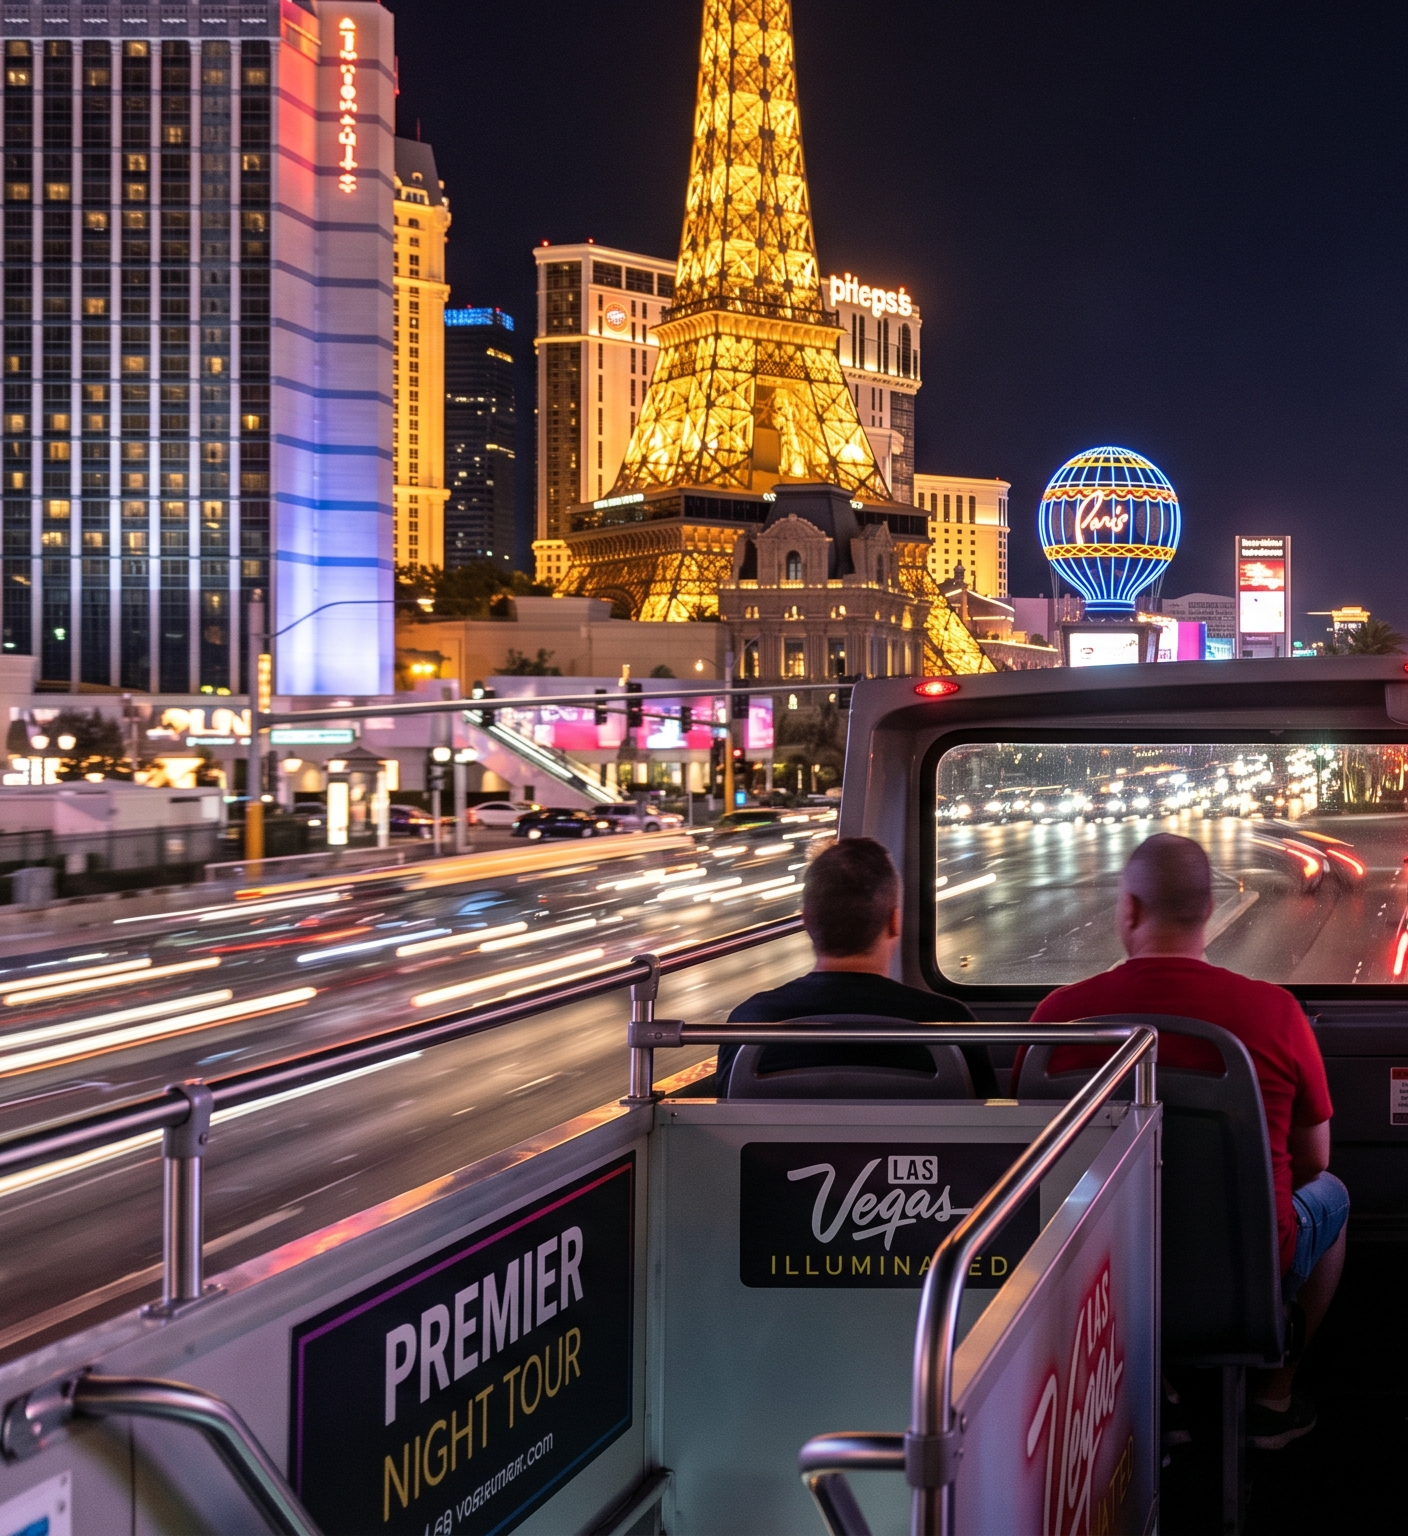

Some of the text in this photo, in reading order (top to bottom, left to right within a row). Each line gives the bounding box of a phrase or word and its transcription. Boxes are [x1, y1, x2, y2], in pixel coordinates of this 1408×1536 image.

[1075, 489, 1129, 545] Paris
[787, 1157, 974, 1251] Vegas
[892, 1159, 935, 1181] LAS
[771, 1255, 1008, 1276] ILLUMINAED
[385, 1225, 584, 1427] PREMIER
[1087, 1269, 1109, 1358] LAS
[383, 1326, 581, 1523] NIGHT TOUR
[1027, 1307, 1123, 1536] Vegas
